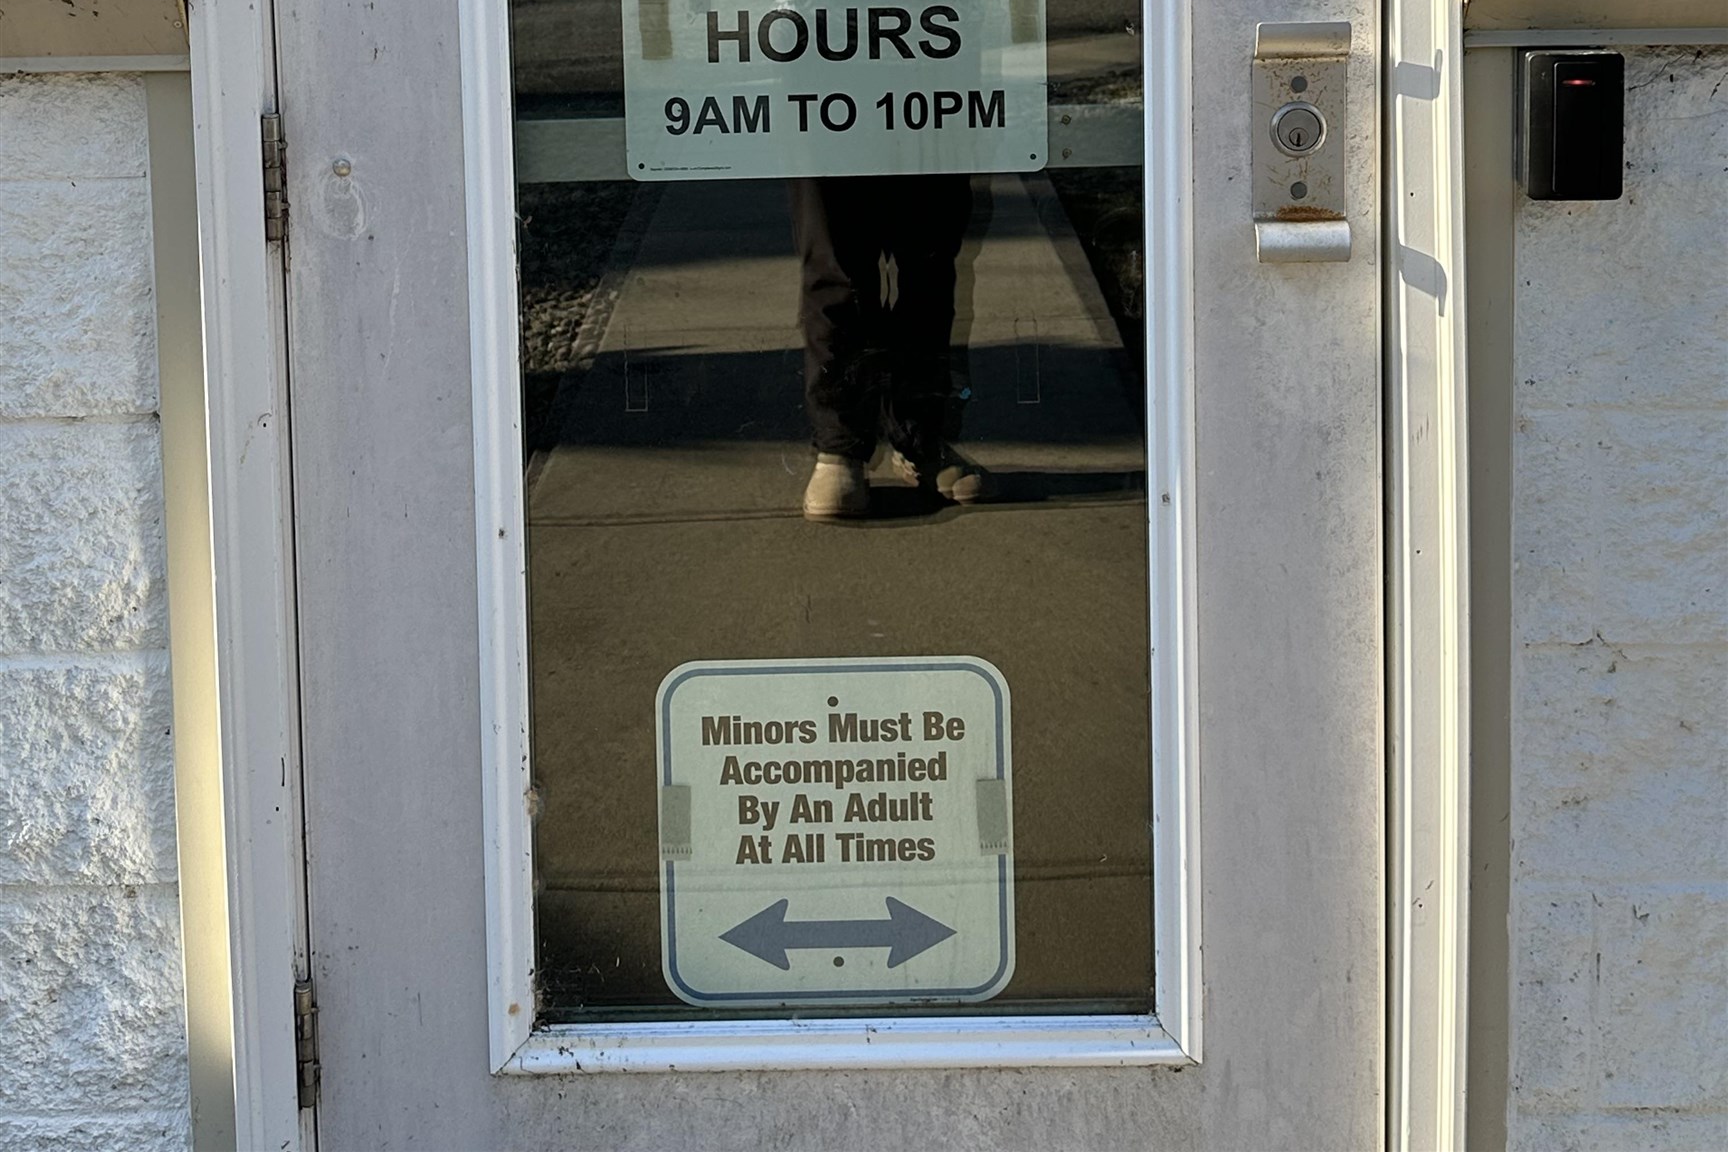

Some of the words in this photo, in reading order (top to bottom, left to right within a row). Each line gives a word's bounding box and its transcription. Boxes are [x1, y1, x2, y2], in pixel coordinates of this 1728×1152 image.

[707, 6, 961, 63] HOURS
[665, 96, 770, 135] 9AM
[788, 93, 856, 131] TO
[877, 90, 1005, 130] 10PM
[702, 716, 817, 745] Minors
[829, 713, 912, 742] Must
[923, 712, 965, 741] Be
[720, 751, 947, 789] Accompanied
[739, 795, 780, 831] By
[790, 794, 833, 823] An
[844, 792, 933, 822] Adult
[736, 835, 772, 864] At
[782, 834, 824, 863] All
[836, 833, 935, 862] Times
